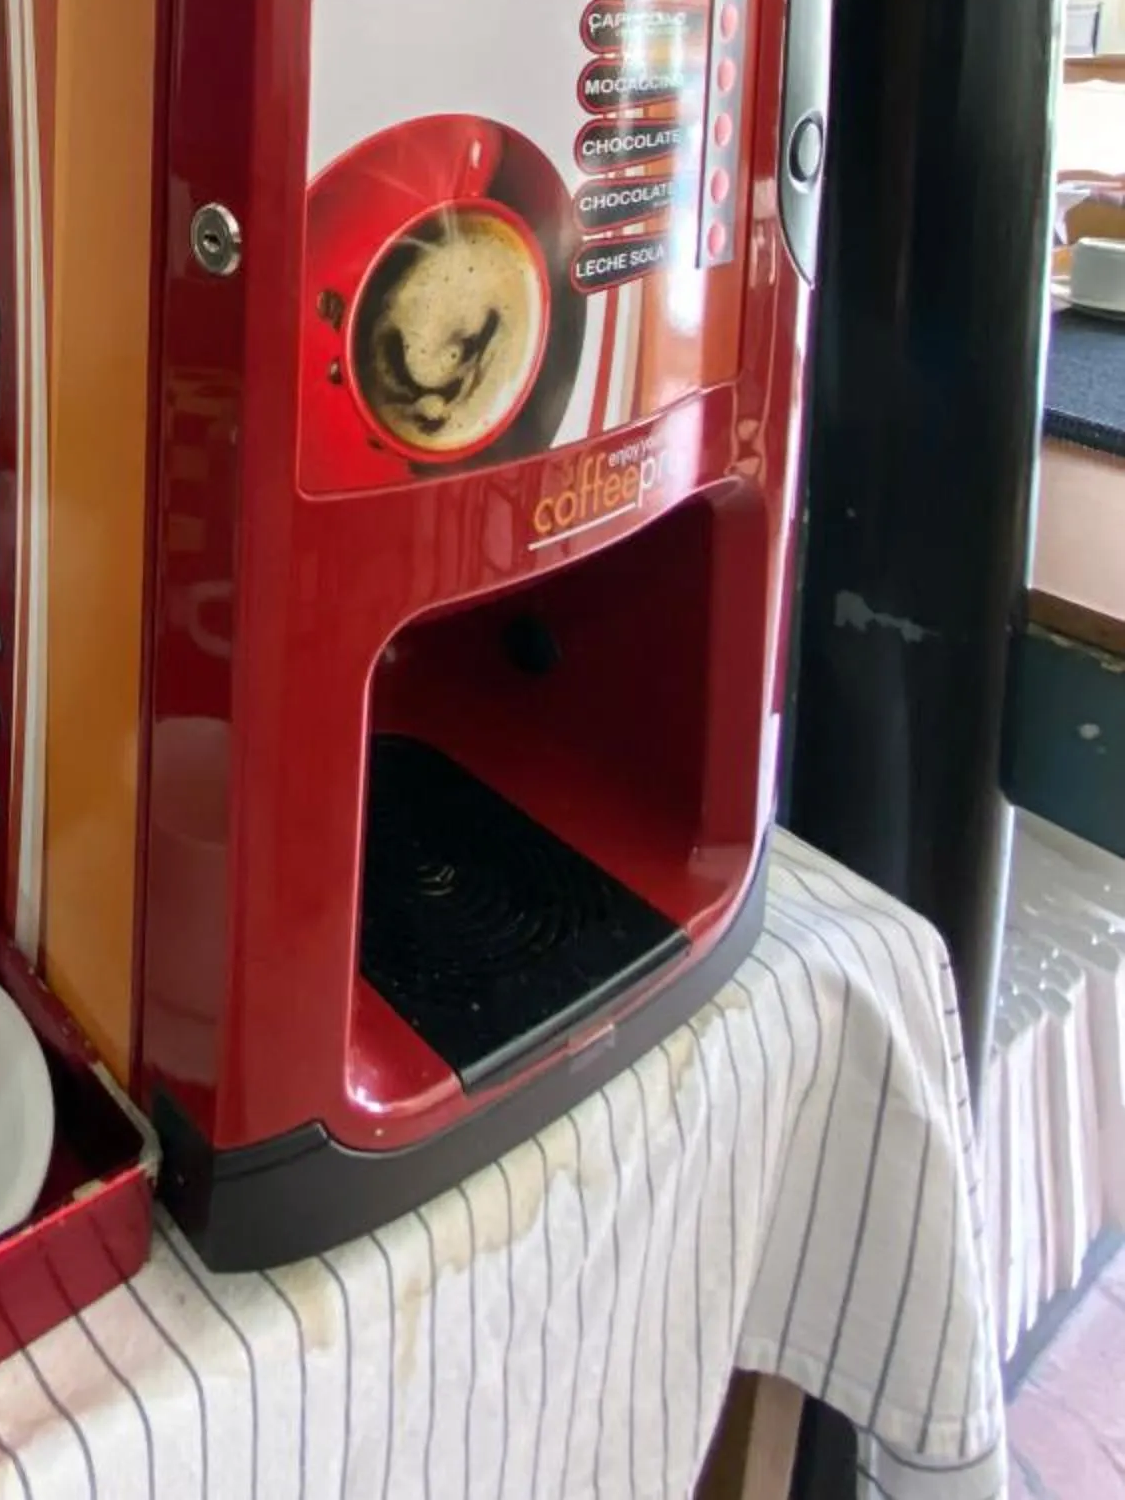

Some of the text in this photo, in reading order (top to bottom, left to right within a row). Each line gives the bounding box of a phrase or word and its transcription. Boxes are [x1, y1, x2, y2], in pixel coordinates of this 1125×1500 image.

[582, 130, 680, 156] CHOCOLATE
[576, 247, 665, 278] LECHE SOLA
[608, 442, 639, 468] enjoy
[533, 451, 673, 534] coffeepr
